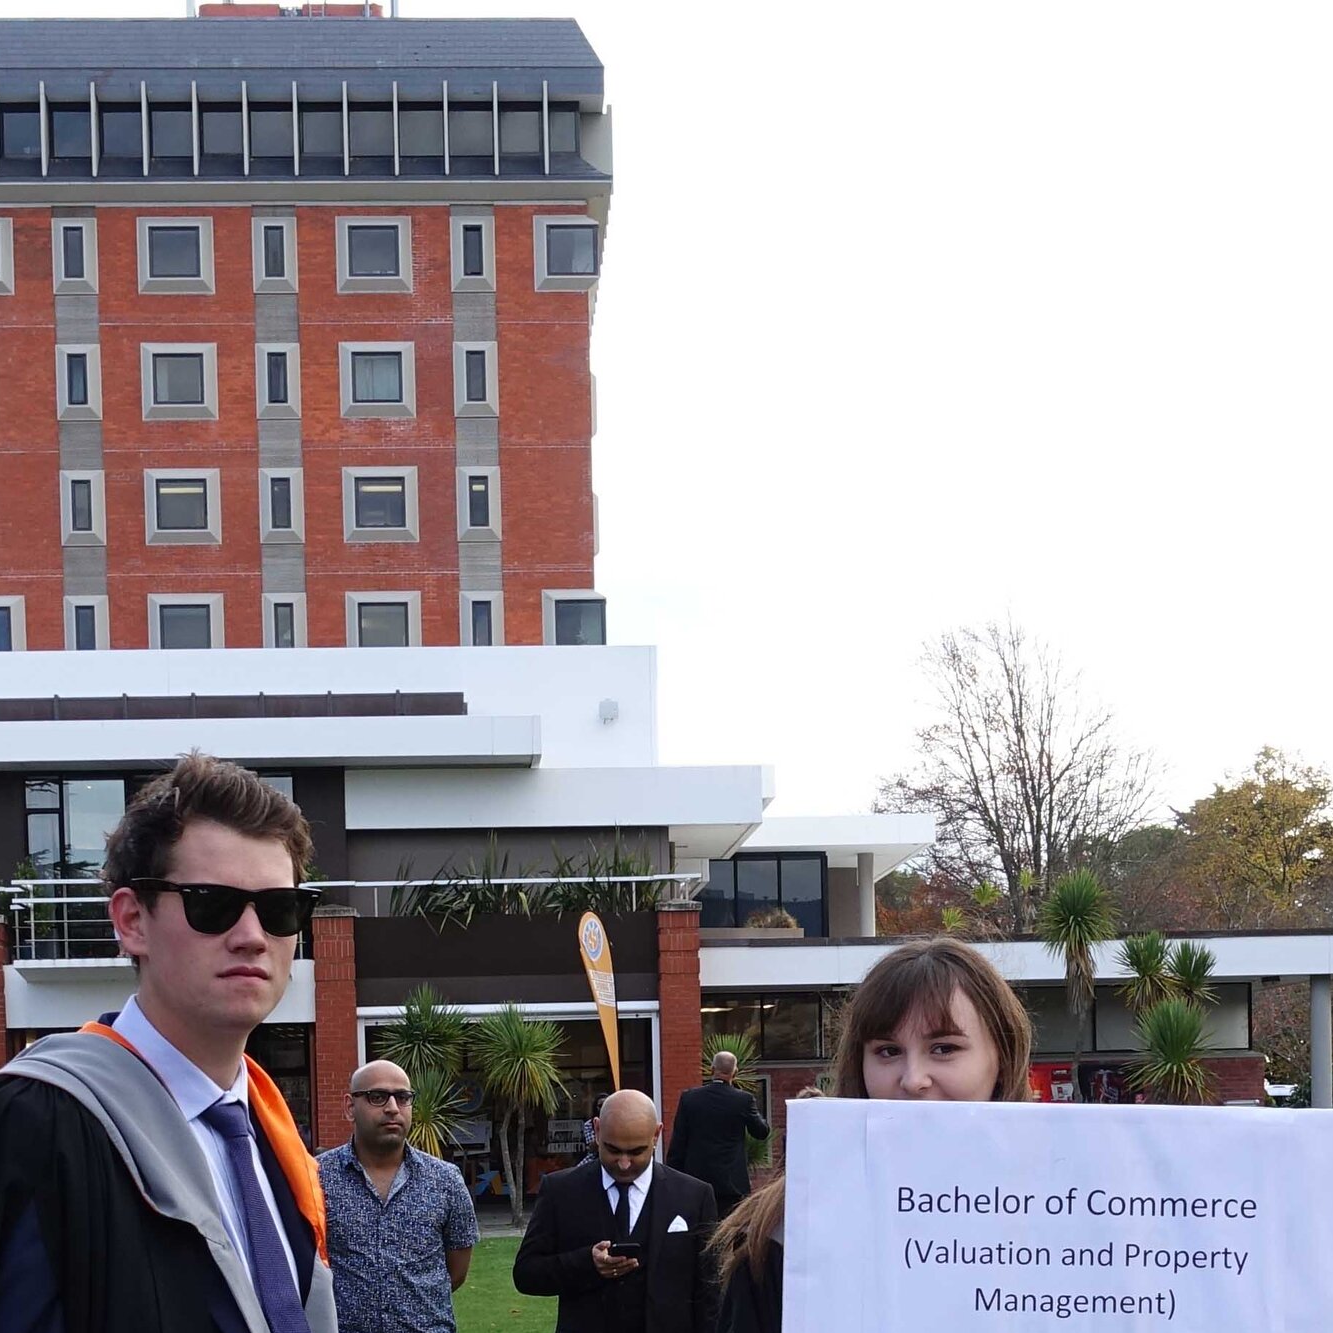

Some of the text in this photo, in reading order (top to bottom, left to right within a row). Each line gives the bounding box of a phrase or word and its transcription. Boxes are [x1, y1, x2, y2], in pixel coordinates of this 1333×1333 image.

[897, 1185, 1257, 1219] Bachelor of Commerce
[904, 1237, 1249, 1276] (Valuation and Property
[975, 1287, 1176, 1321] Management)
